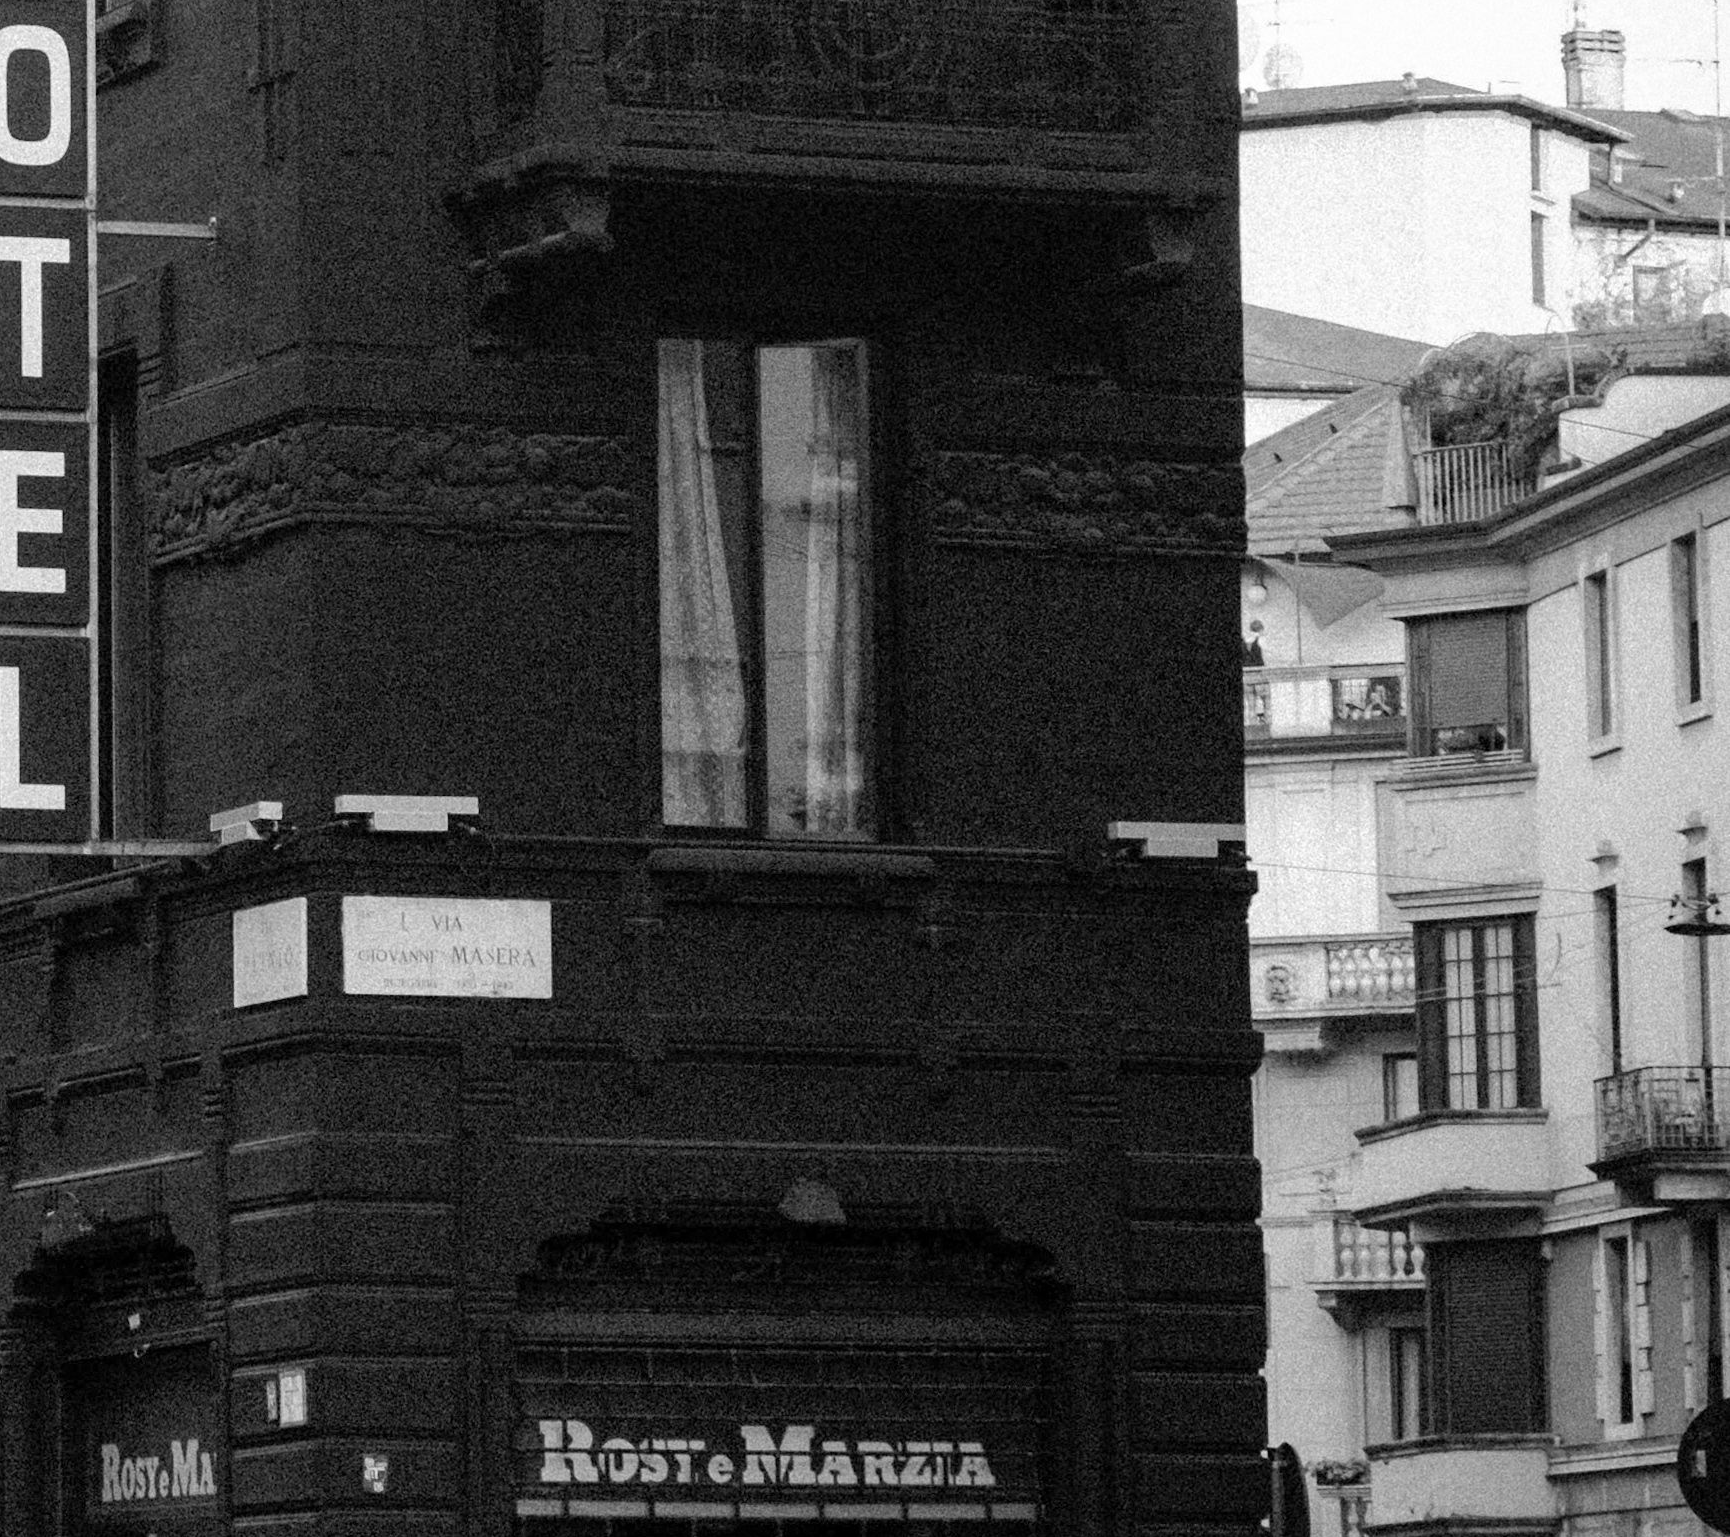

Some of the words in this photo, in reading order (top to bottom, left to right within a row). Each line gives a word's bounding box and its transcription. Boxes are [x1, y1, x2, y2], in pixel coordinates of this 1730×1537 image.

[431, 914, 463, 932] VIA
[357, 948, 435, 964] GIOVANNI
[451, 945, 537, 968] MASERA
[170, 1438, 218, 1498] MA
